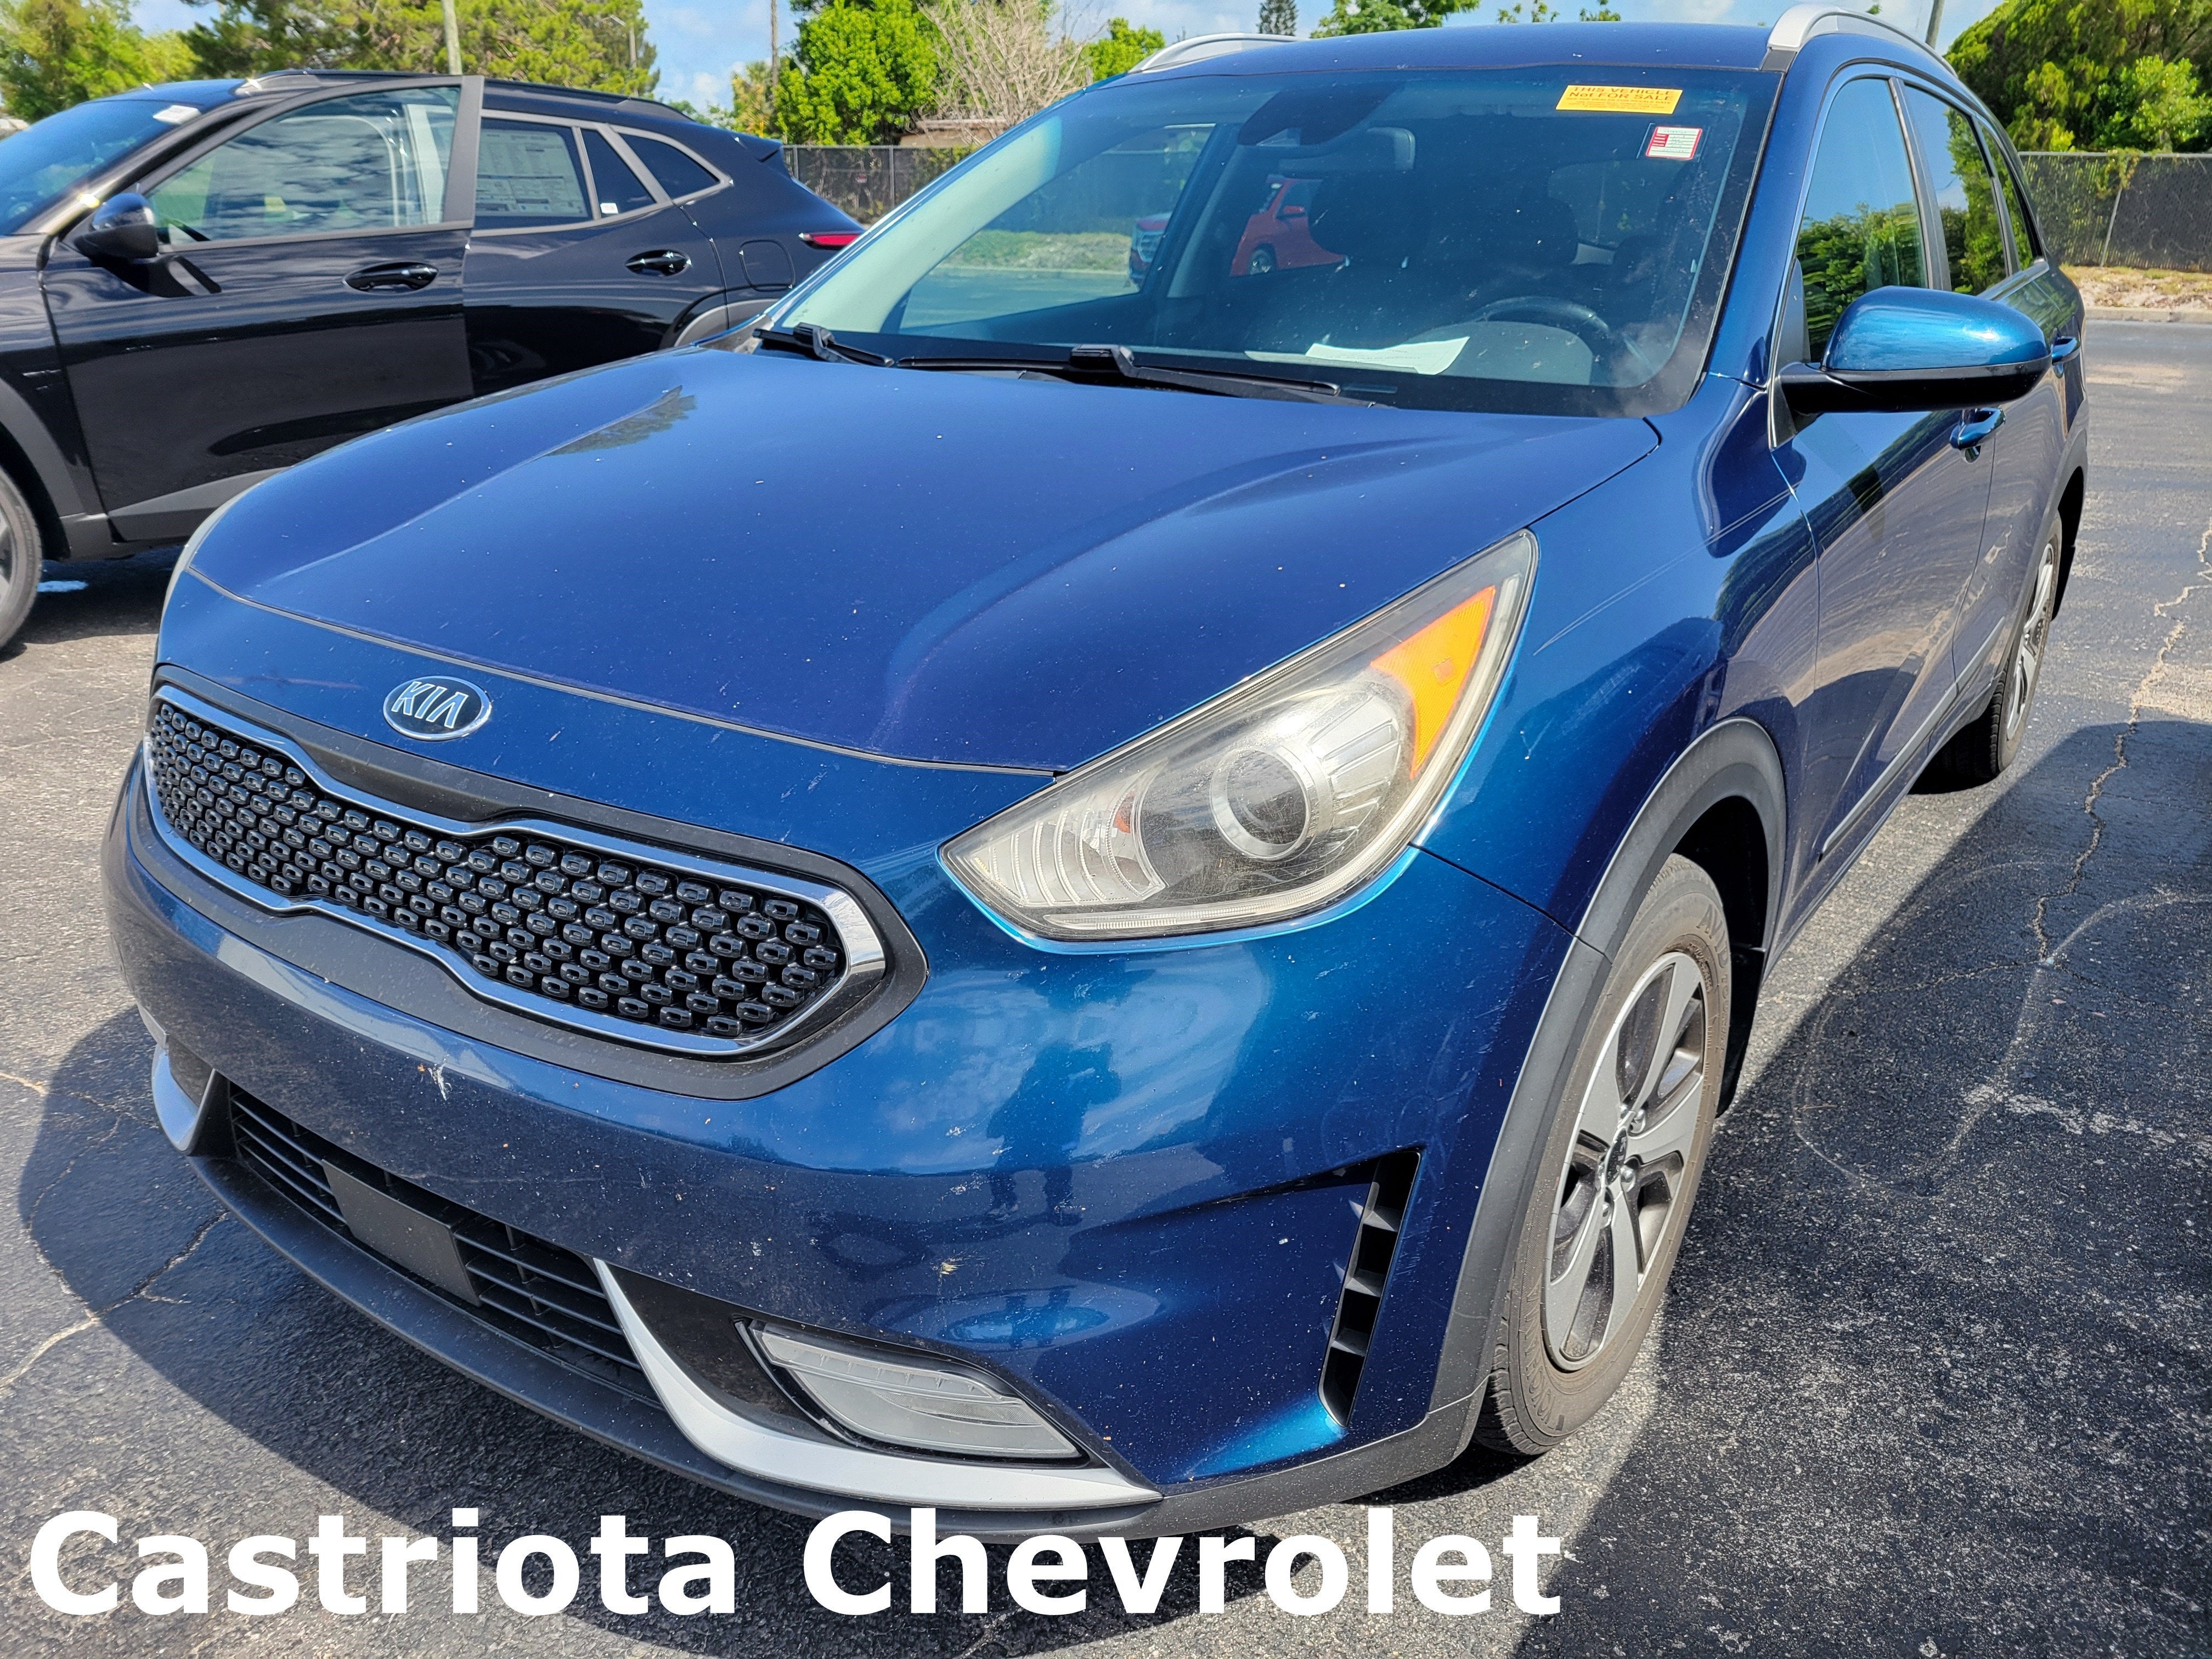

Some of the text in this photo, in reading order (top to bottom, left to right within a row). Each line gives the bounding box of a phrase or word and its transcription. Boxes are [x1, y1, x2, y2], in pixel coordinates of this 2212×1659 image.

[391, 681, 469, 729] KIA
[1696, 904, 1729, 969] AVID
[1525, 1273, 1556, 1425] YOKOHAMA
